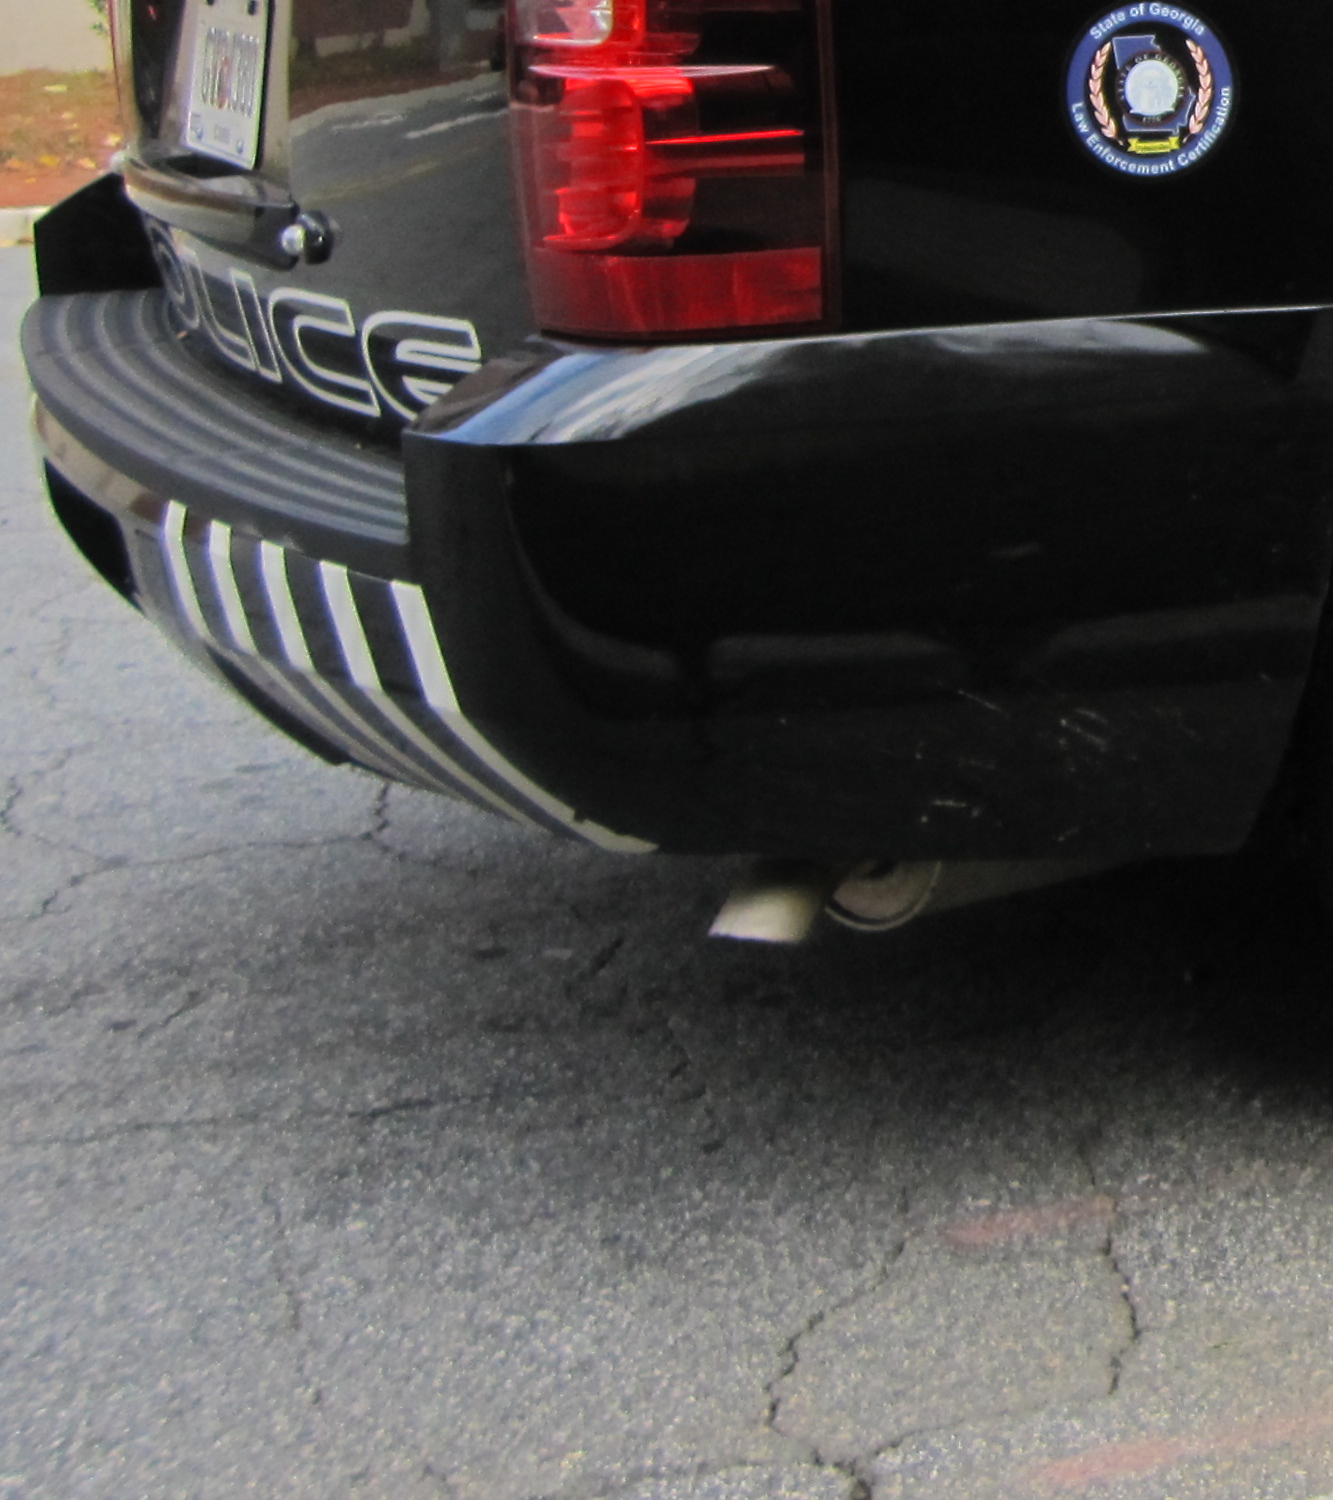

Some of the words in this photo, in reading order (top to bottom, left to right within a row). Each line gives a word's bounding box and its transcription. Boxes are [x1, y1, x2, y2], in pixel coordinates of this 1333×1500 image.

[1089, 11, 1127, 40] State
[1130, 3, 1146, 17] of
[1149, 2, 1206, 36] Georgia
[1071, 102, 1089, 134] Law
[1087, 135, 1175, 175] Enforcement
[1177, 86, 1232, 166] Certification
